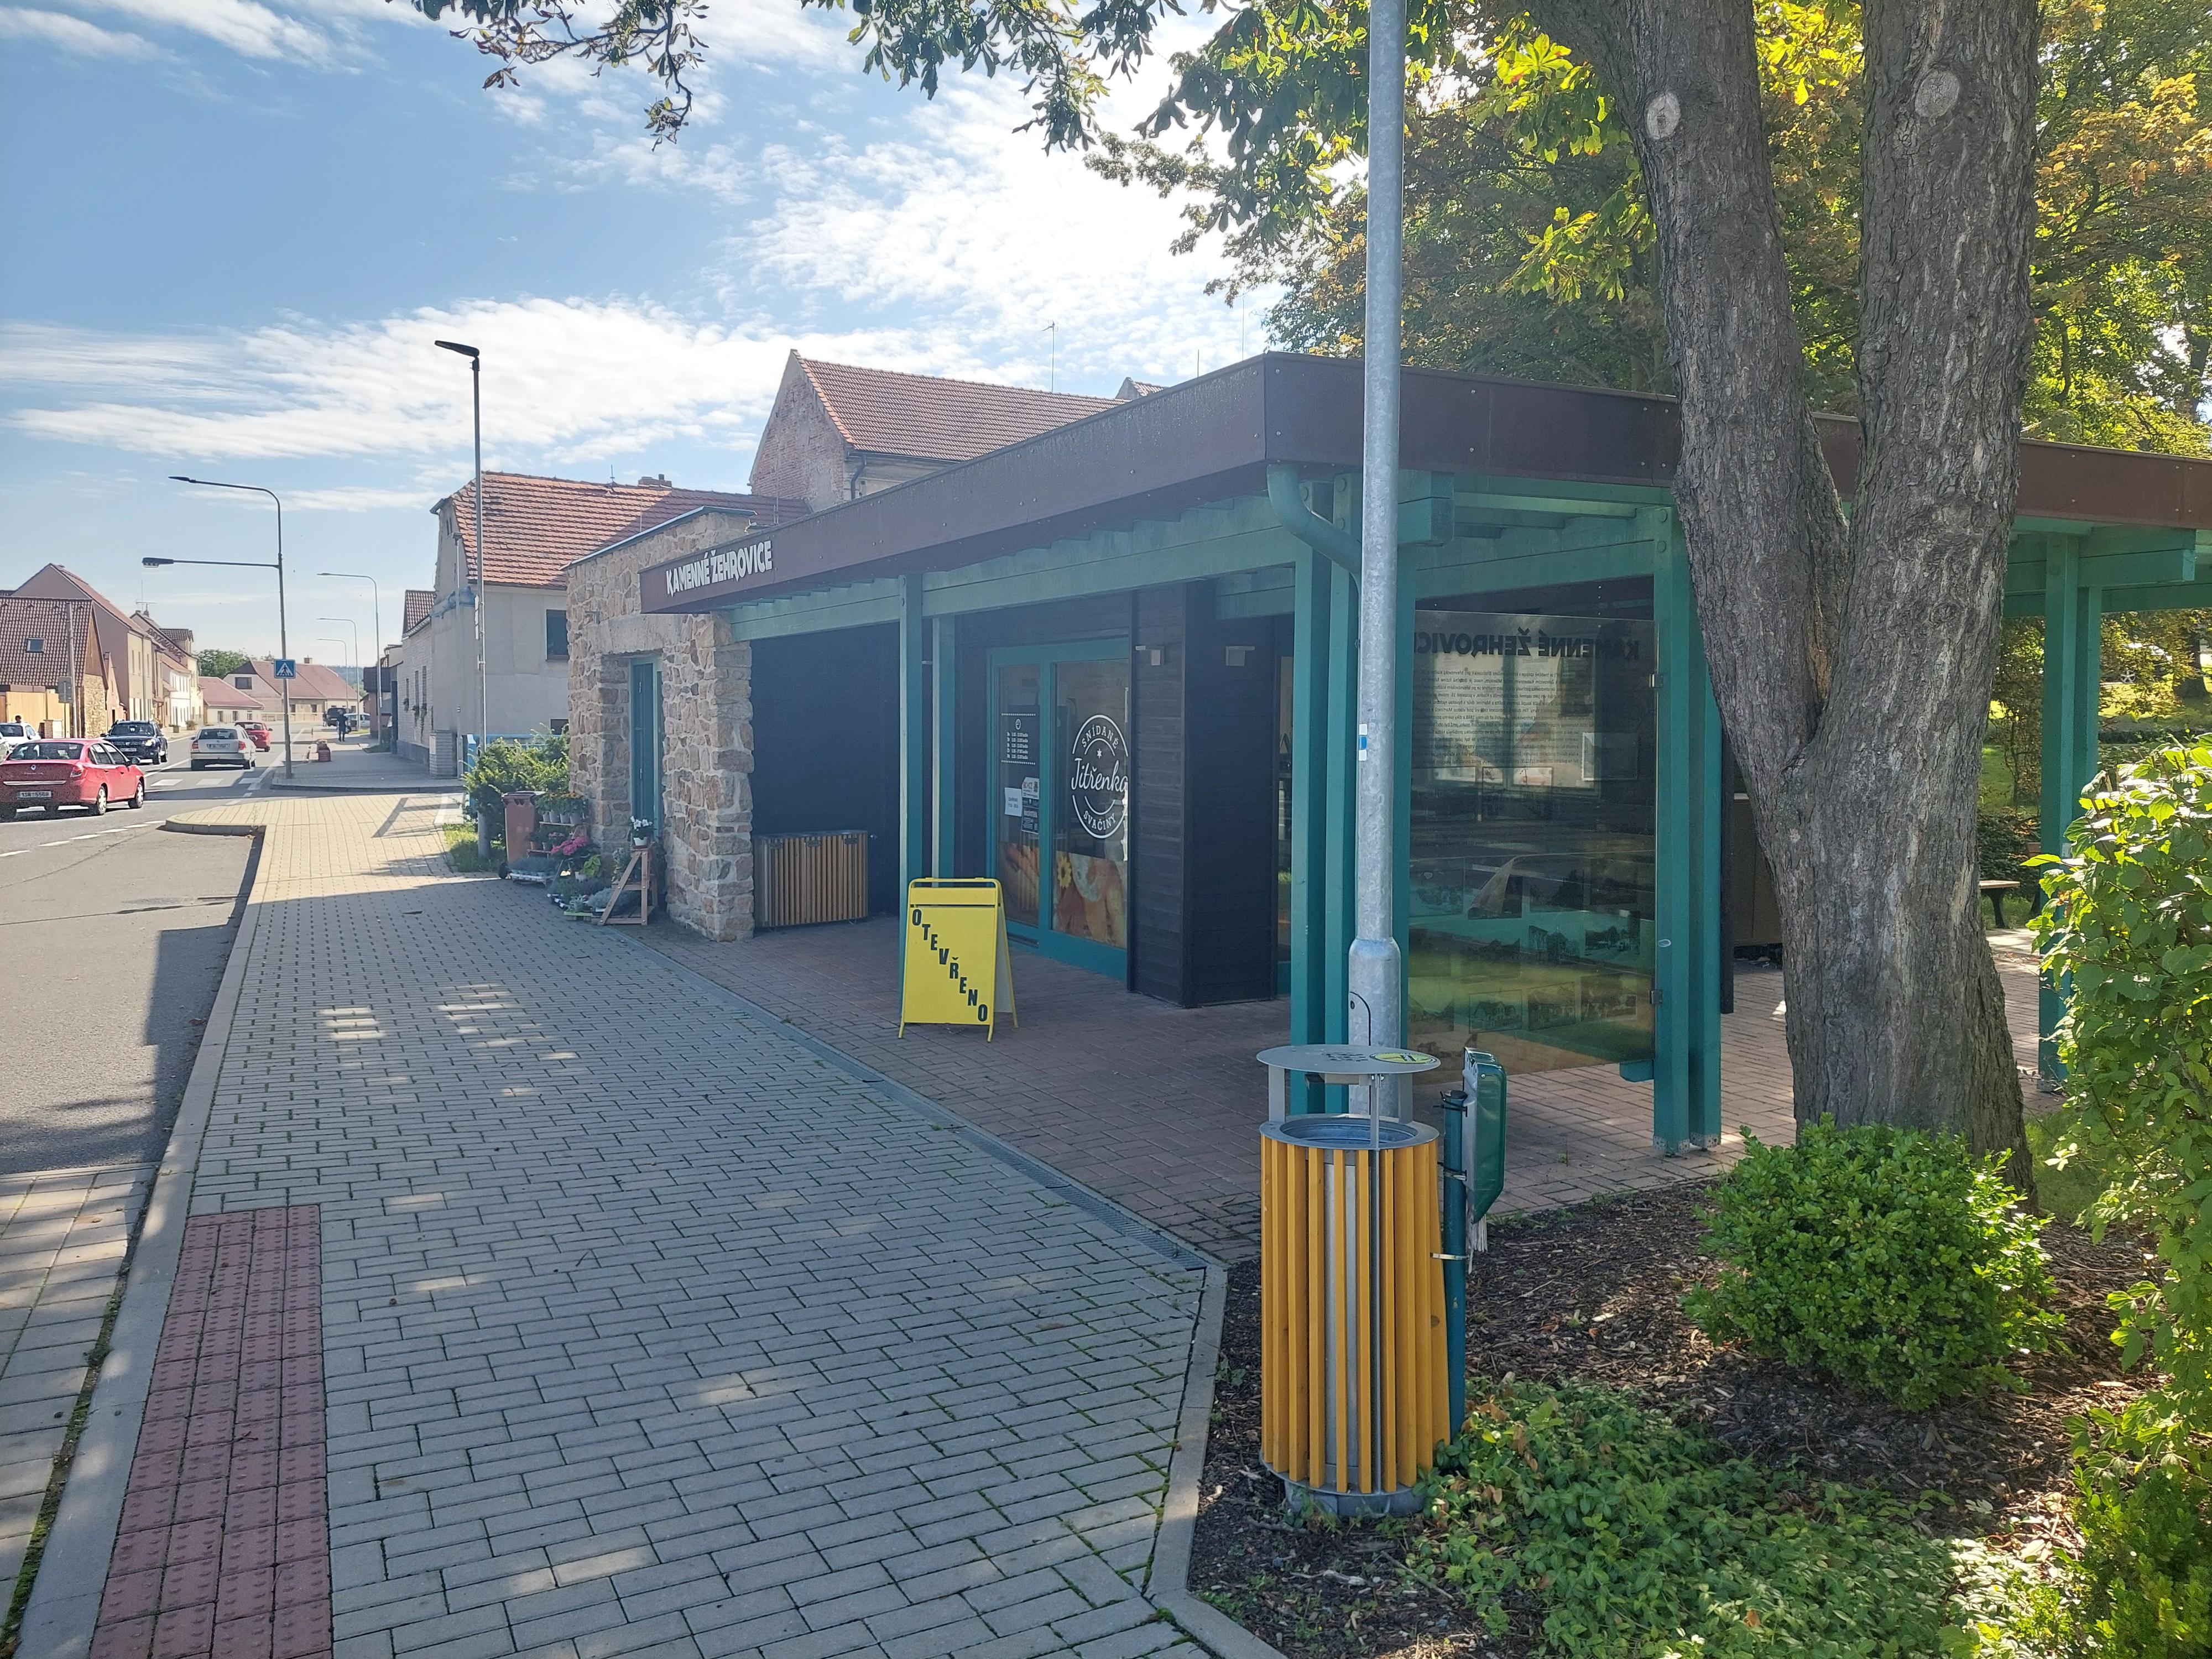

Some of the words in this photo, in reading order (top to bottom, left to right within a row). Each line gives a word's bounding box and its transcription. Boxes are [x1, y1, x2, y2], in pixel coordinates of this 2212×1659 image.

[666, 552, 711, 597] KAMENNÉ
[710, 540, 773, 583] ŽEHROVICE
[1082, 724, 1119, 749] SNÍDANĚ
[1071, 757, 1129, 793] Jitřenka
[1083, 810, 1117, 831] SVAČINY
[912, 909, 988, 1022] OTEVŘENO
